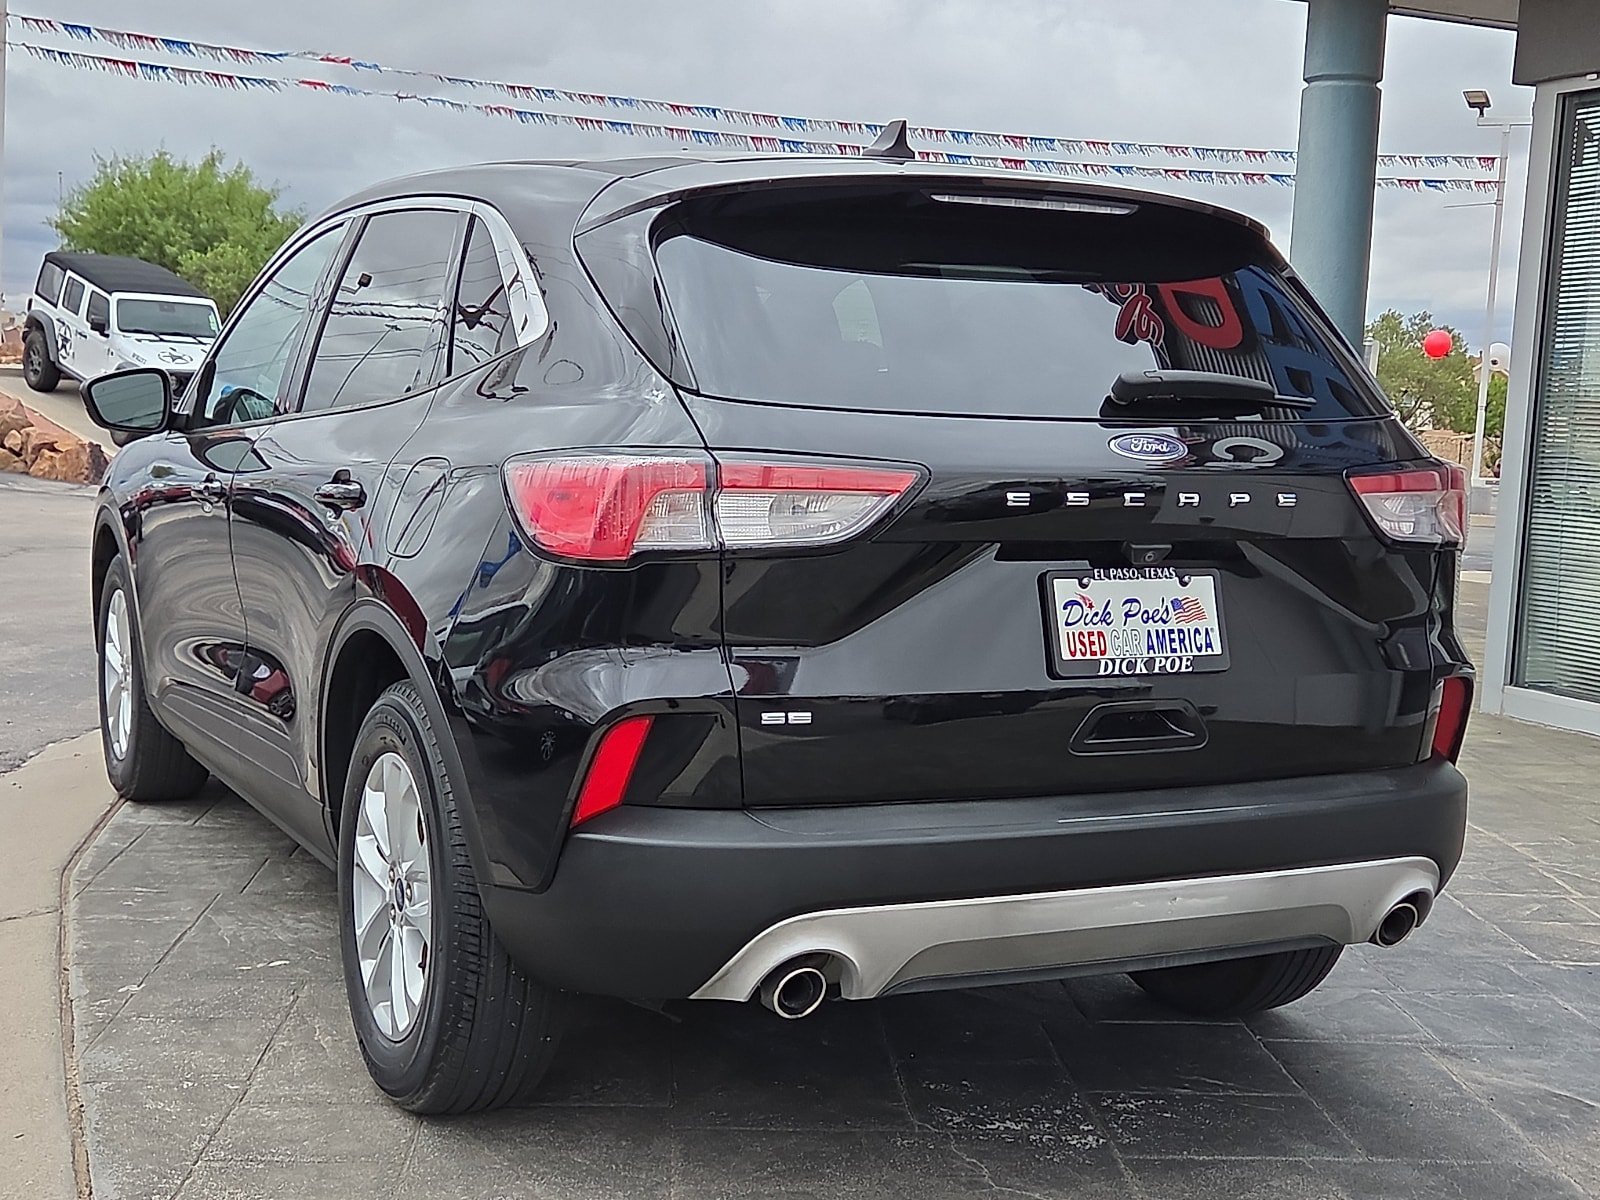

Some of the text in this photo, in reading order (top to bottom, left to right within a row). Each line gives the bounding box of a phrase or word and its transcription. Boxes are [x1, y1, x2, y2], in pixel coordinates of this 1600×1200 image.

[1006, 491, 1297, 507] ESCAPE
[1093, 567, 1177, 580] EL PASO, TEXAS
[1062, 597, 1172, 627] Dick Poe's
[1065, 626, 1215, 658] USED CAR AMERICA
[1097, 656, 1194, 676] DICK POE
[760, 711, 813, 725] SE
